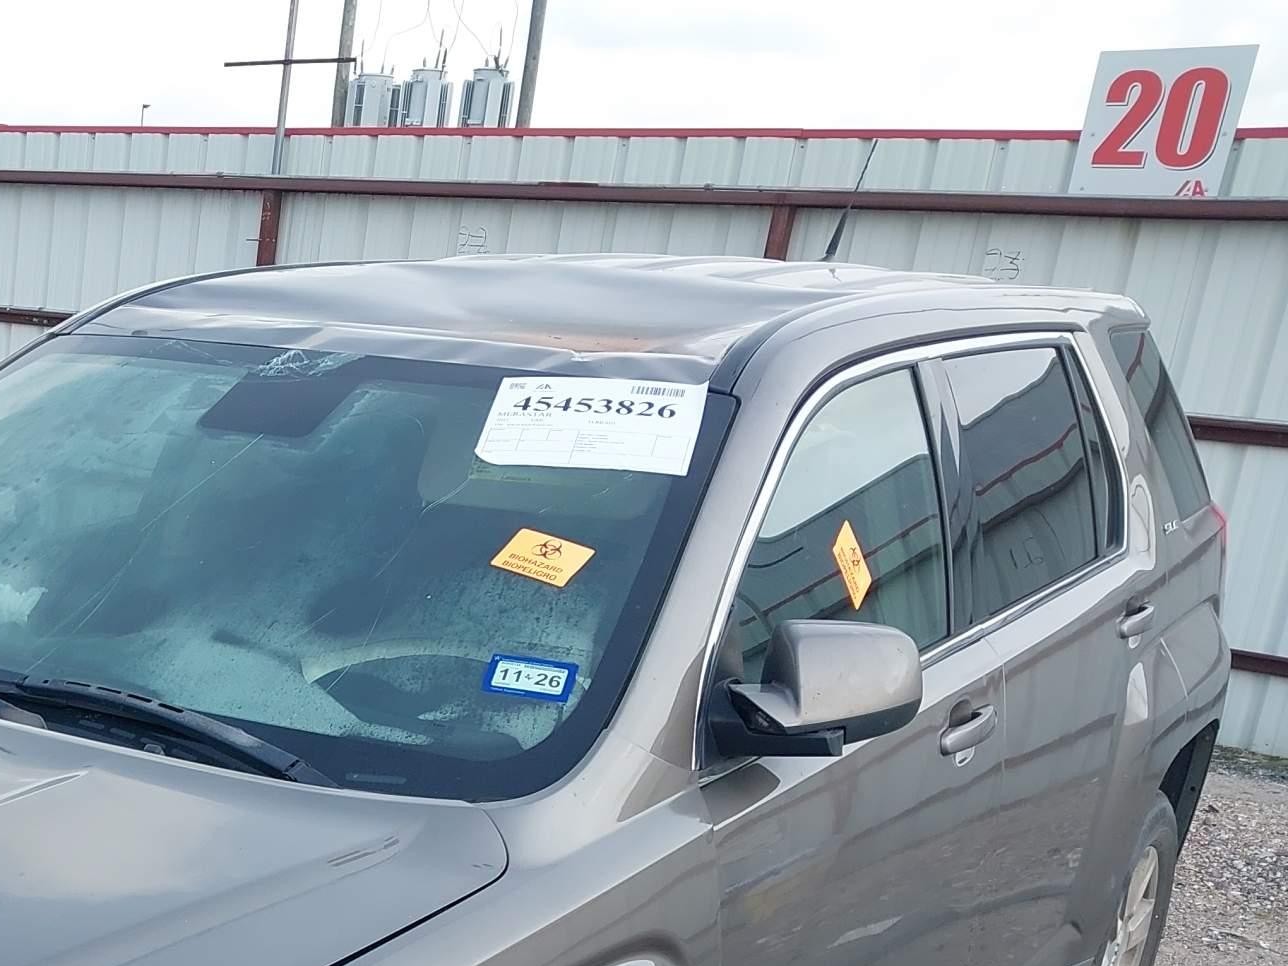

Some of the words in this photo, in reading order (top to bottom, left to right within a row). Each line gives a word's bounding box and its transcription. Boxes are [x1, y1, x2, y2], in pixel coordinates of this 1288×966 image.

[1091, 65, 1231, 171] 20
[513, 396, 680, 418] 45453826
[501, 560, 558, 581] BIOPELIGRO
[509, 552, 564, 574] BIOHAZARD
